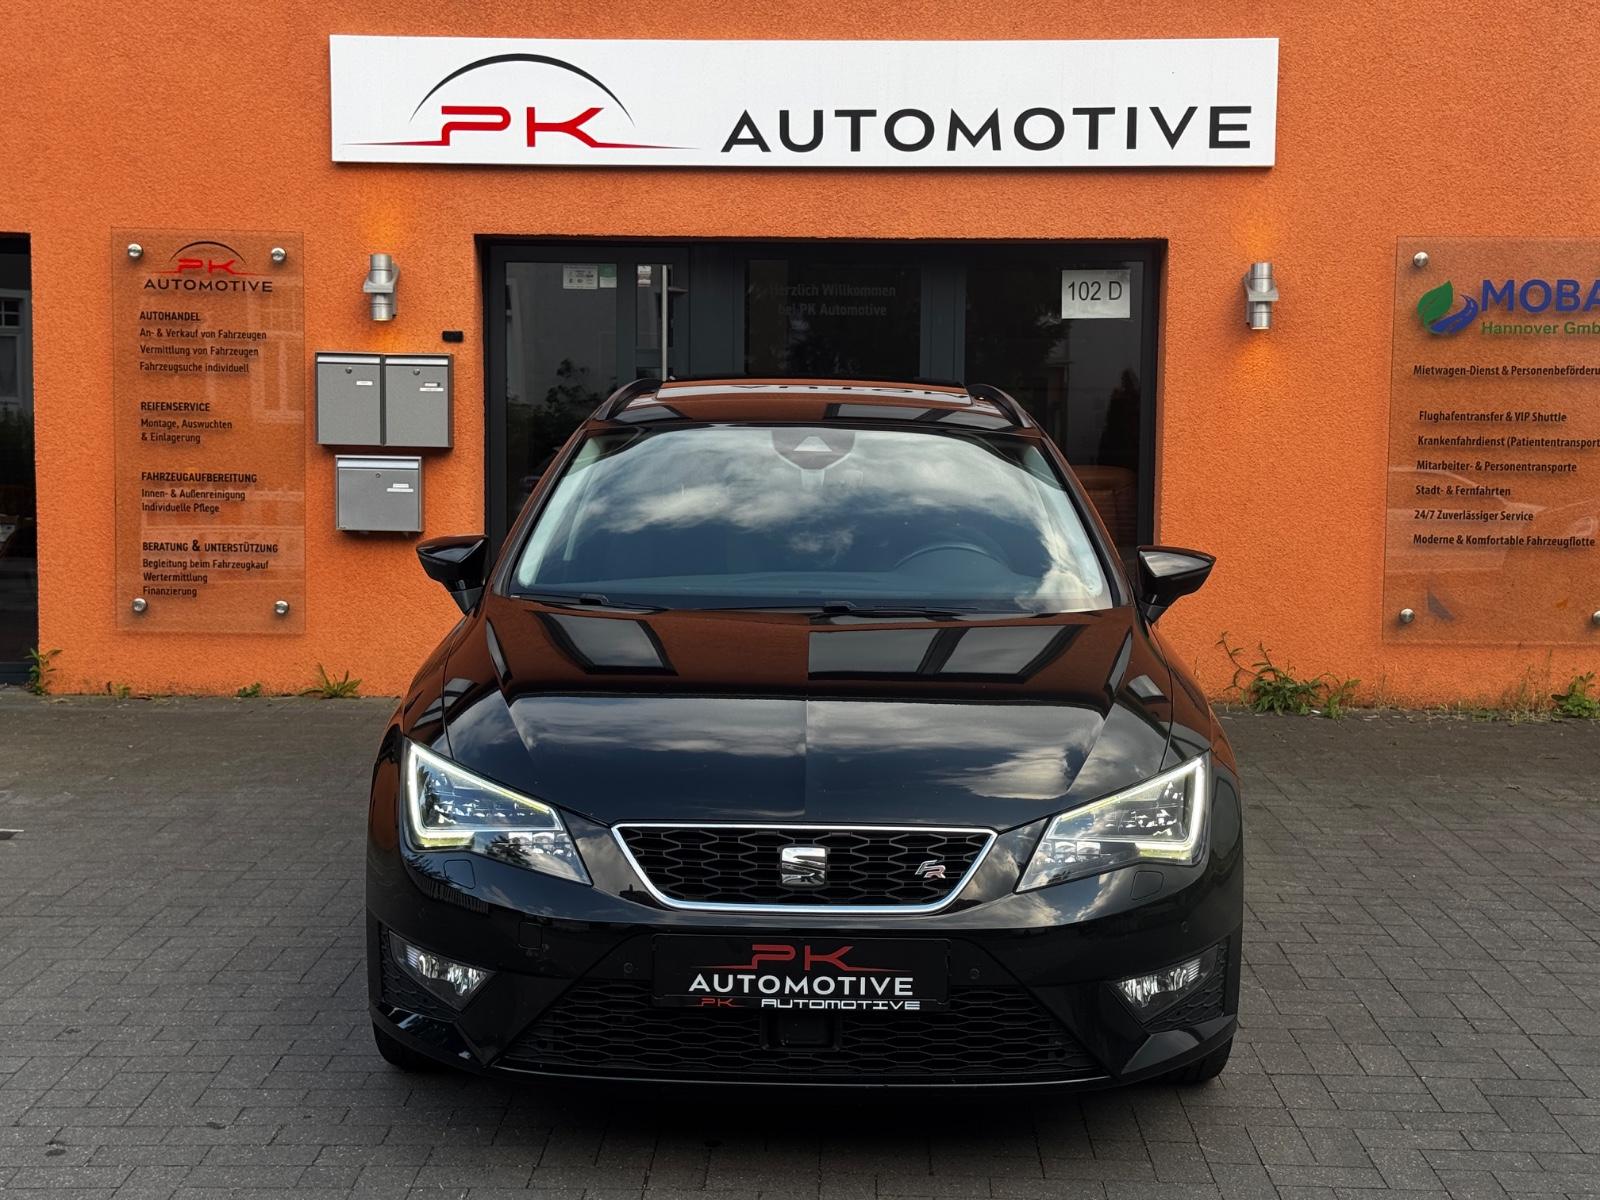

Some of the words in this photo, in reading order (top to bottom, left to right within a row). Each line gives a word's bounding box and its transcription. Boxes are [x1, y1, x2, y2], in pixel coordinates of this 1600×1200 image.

[440, 105, 605, 148] PK
[721, 105, 1253, 154] AUTOMOTIVE
[178, 258, 236, 276] PK
[143, 278, 273, 292] AUTOMOTIVE
[822, 283, 896, 297] Willkommen
[1067, 280, 1101, 301] 102
[1108, 280, 1122, 300] D
[139, 311, 200, 321] AUTOHANDEL
[778, 303, 797, 316] bei
[800, 303, 816, 316] PK
[820, 303, 887, 317] Automotive
[139, 328, 155, 338] An-
[156, 328, 163, 338] &
[166, 328, 198, 339] Verkauf
[201, 331, 216, 339] von
[218, 329, 267, 342] Fahrzeugen
[1481, 321, 1558, 335] Hannover
[139, 345, 191, 357] Vermittlung
[193, 347, 208, 355] von
[210, 346, 258, 358] Fahrzeugen
[139, 361, 203, 374] Fahrzeugsuche
[205, 363, 249, 373] individuell
[1413, 365, 1500, 378] Mietwagen-Dienst
[1502, 365, 1509, 375] &
[1511, 364, 1600, 376] Personenbeförderu
[140, 401, 210, 412] REIFENSERVICE
[1419, 410, 1503, 423] Flughafentransfer
[1505, 411, 1513, 422] &
[1514, 411, 1530, 422] VIP
[1532, 411, 1567, 422] Shuttle
[140, 418, 180, 430] Montage,
[181, 419, 233, 429] Auswuchten
[141, 433, 148, 442] &
[150, 433, 201, 444] Einlagerung
[1417, 435, 1505, 447] Krankenfahrdienst
[1507, 436, 1600, 450] (Patiententransport
[1416, 460, 1473, 471] Mitarbeiter-
[1475, 461, 1482, 471] &
[1484, 461, 1577, 474] Personentransporte
[141, 472, 257, 483] FAHRZEUGAUFBEREITUNG
[141, 489, 168, 498] Innen-
[170, 489, 177, 498] &
[179, 489, 245, 501] Außenreinigung
[1415, 485, 1444, 495] Stadt-
[1446, 485, 1453, 495] &
[1455, 485, 1511, 496] Fernfahrten
[142, 503, 191, 513] Individuelle
[193, 504, 220, 515] Pflege
[1414, 509, 1435, 520] 24/7
[1437, 510, 1498, 523] Zuverlässiger
[1500, 511, 1534, 521] Service
[142, 542, 188, 552] BERATUNG
[192, 539, 200, 552] &
[204, 541, 278, 553] UNTERSTÜTZUNG
[1413, 534, 1455, 545] Moderne
[1456, 534, 1464, 545] &
[1465, 534, 1525, 546] Komfortable
[1526, 535, 1595, 548] Fahrzeugflotte
[142, 559, 187, 570] Begleitung
[189, 559, 210, 569] beim
[212, 559, 268, 571] Fahrzeugkauf
[143, 572, 208, 584] Wertermittlung
[143, 586, 197, 597] Finanzierung
[751, 944, 853, 971] PK
[688, 974, 914, 996] AUTOMOTIVE
[701, 998, 734, 1007] PK
[761, 998, 920, 1010] AUTOMOTIVE
